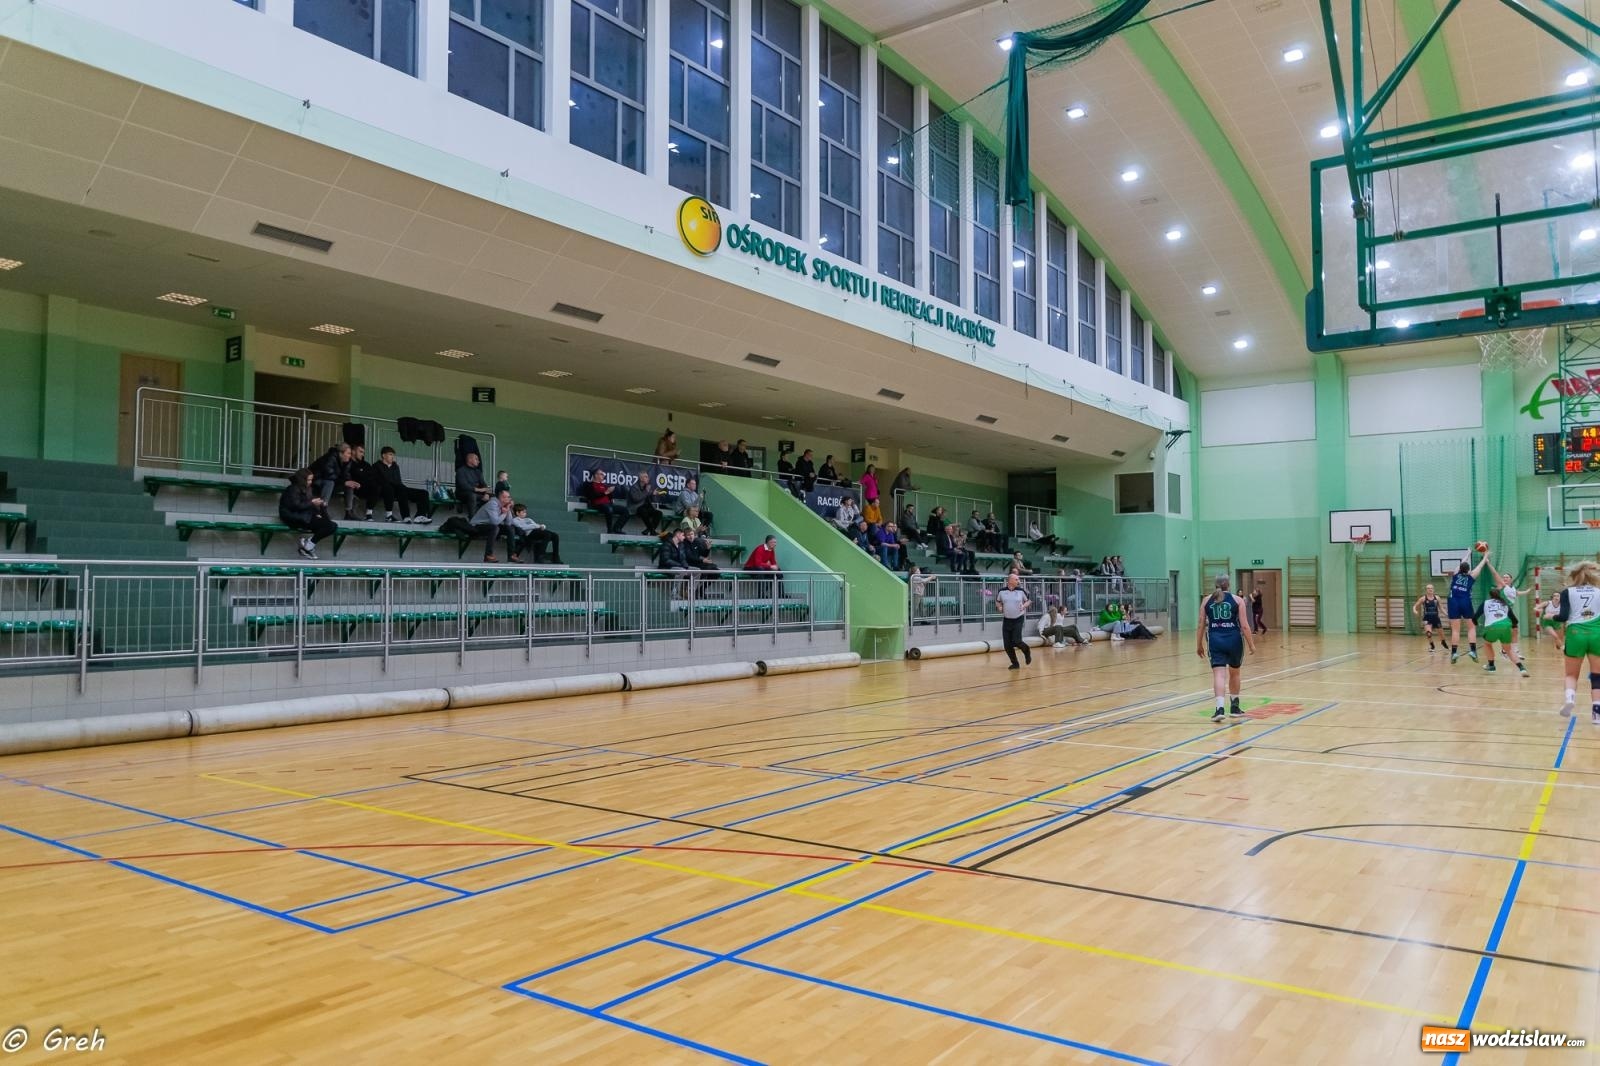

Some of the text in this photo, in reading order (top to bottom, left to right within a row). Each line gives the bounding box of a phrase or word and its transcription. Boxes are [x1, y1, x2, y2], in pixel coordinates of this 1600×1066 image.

[726, 223, 996, 348] OŚRODEK SPORTU I REKREACJI RACIBÓRZ
[229, 345, 239, 360] E
[478, 392, 489, 402] E
[656, 473, 687, 491] OSiR
[1580, 593, 1594, 609] 7
[1209, 601, 1232, 619] 18
